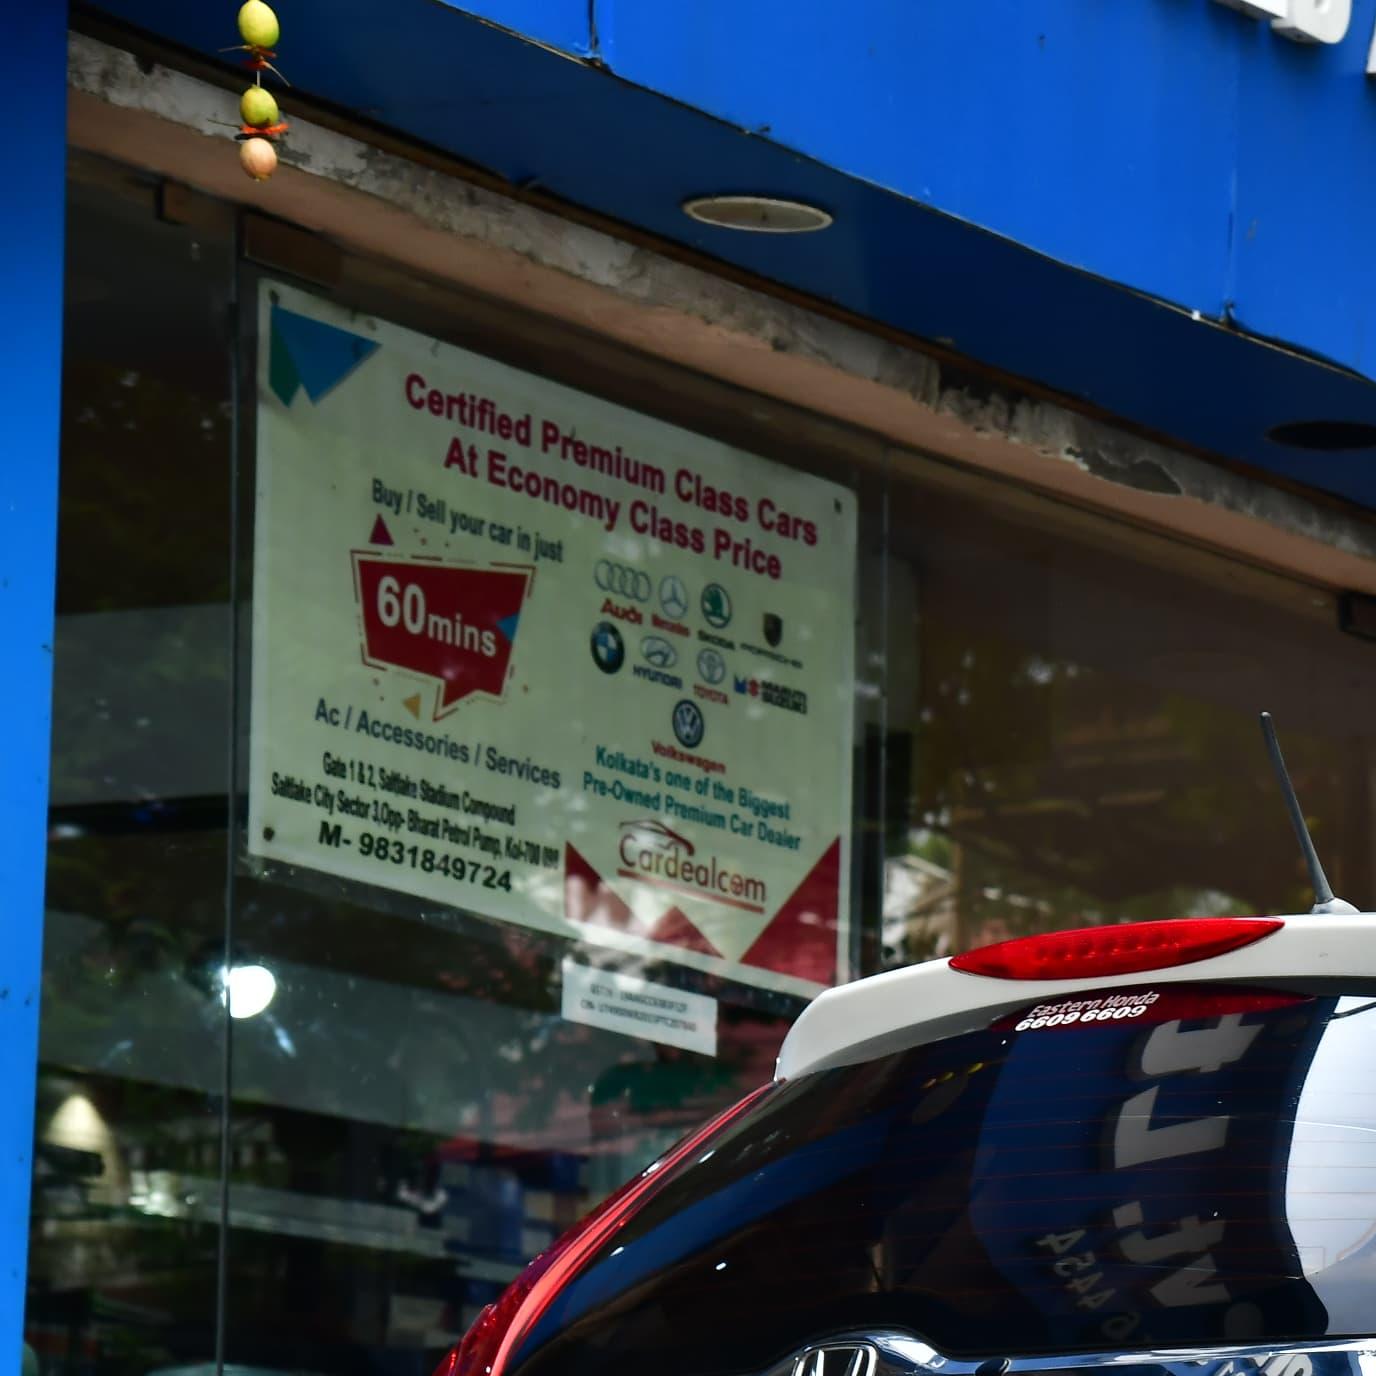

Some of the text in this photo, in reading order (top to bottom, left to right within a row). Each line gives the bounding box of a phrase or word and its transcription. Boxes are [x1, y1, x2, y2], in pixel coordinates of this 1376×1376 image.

[405, 373, 818, 546] Certified Premium Class Cars
[372, 478, 403, 516] Buy
[417, 493, 446, 524] Sell
[450, 508, 485, 536] your
[489, 522, 513, 545] car
[517, 526, 531, 552] in
[533, 531, 564, 563] just
[444, 437, 782, 580] At Economy Class Price
[601, 598, 643, 624] Audi
[315, 697, 340, 727] Ac
[356, 709, 470, 763] Accessories
[485, 747, 561, 789] Services
[651, 739, 727, 775] Volkswagen
[314, 783, 335, 815] City
[337, 790, 370, 820] Sector
[407, 809, 440, 841] Bharat
[322, 751, 346, 779] Gate
[420, 779, 460, 811] Stadium
[462, 791, 516, 826] Compound
[583, 771, 802, 850] Pre-Owned Premium Car Dealer
[596, 745, 790, 821] Kolkata's one of the Biggest
[359, 832, 512, 893] 9831849724
[618, 833, 767, 901] Cardealcom
[1015, 1005, 1147, 1032] 6609 6609
[1026, 991, 1160, 1018] Eastern Honda
